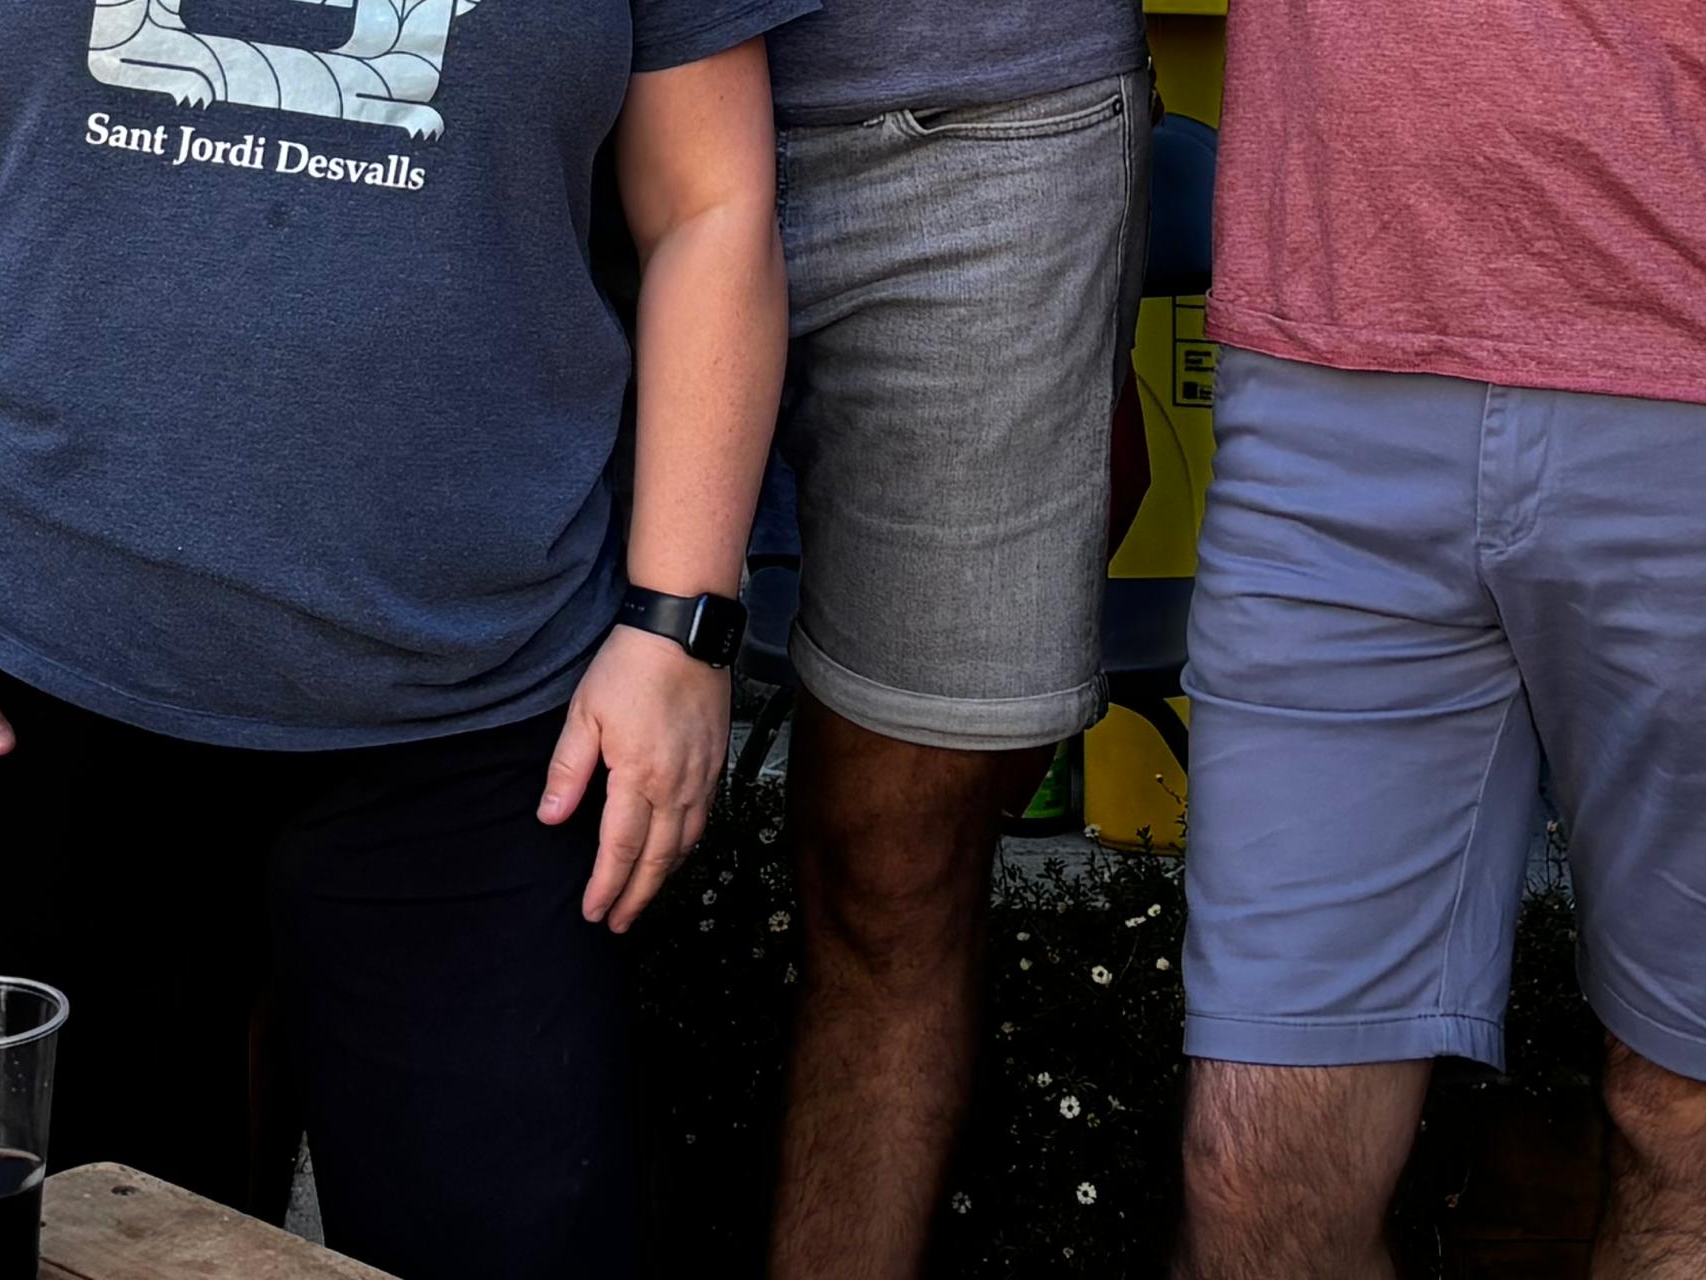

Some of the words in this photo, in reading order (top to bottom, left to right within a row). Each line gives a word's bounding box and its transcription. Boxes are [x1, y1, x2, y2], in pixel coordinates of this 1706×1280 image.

[85, 112, 167, 155] Sant
[173, 126, 265, 170] Jordi
[276, 140, 426, 191] Desvalls
